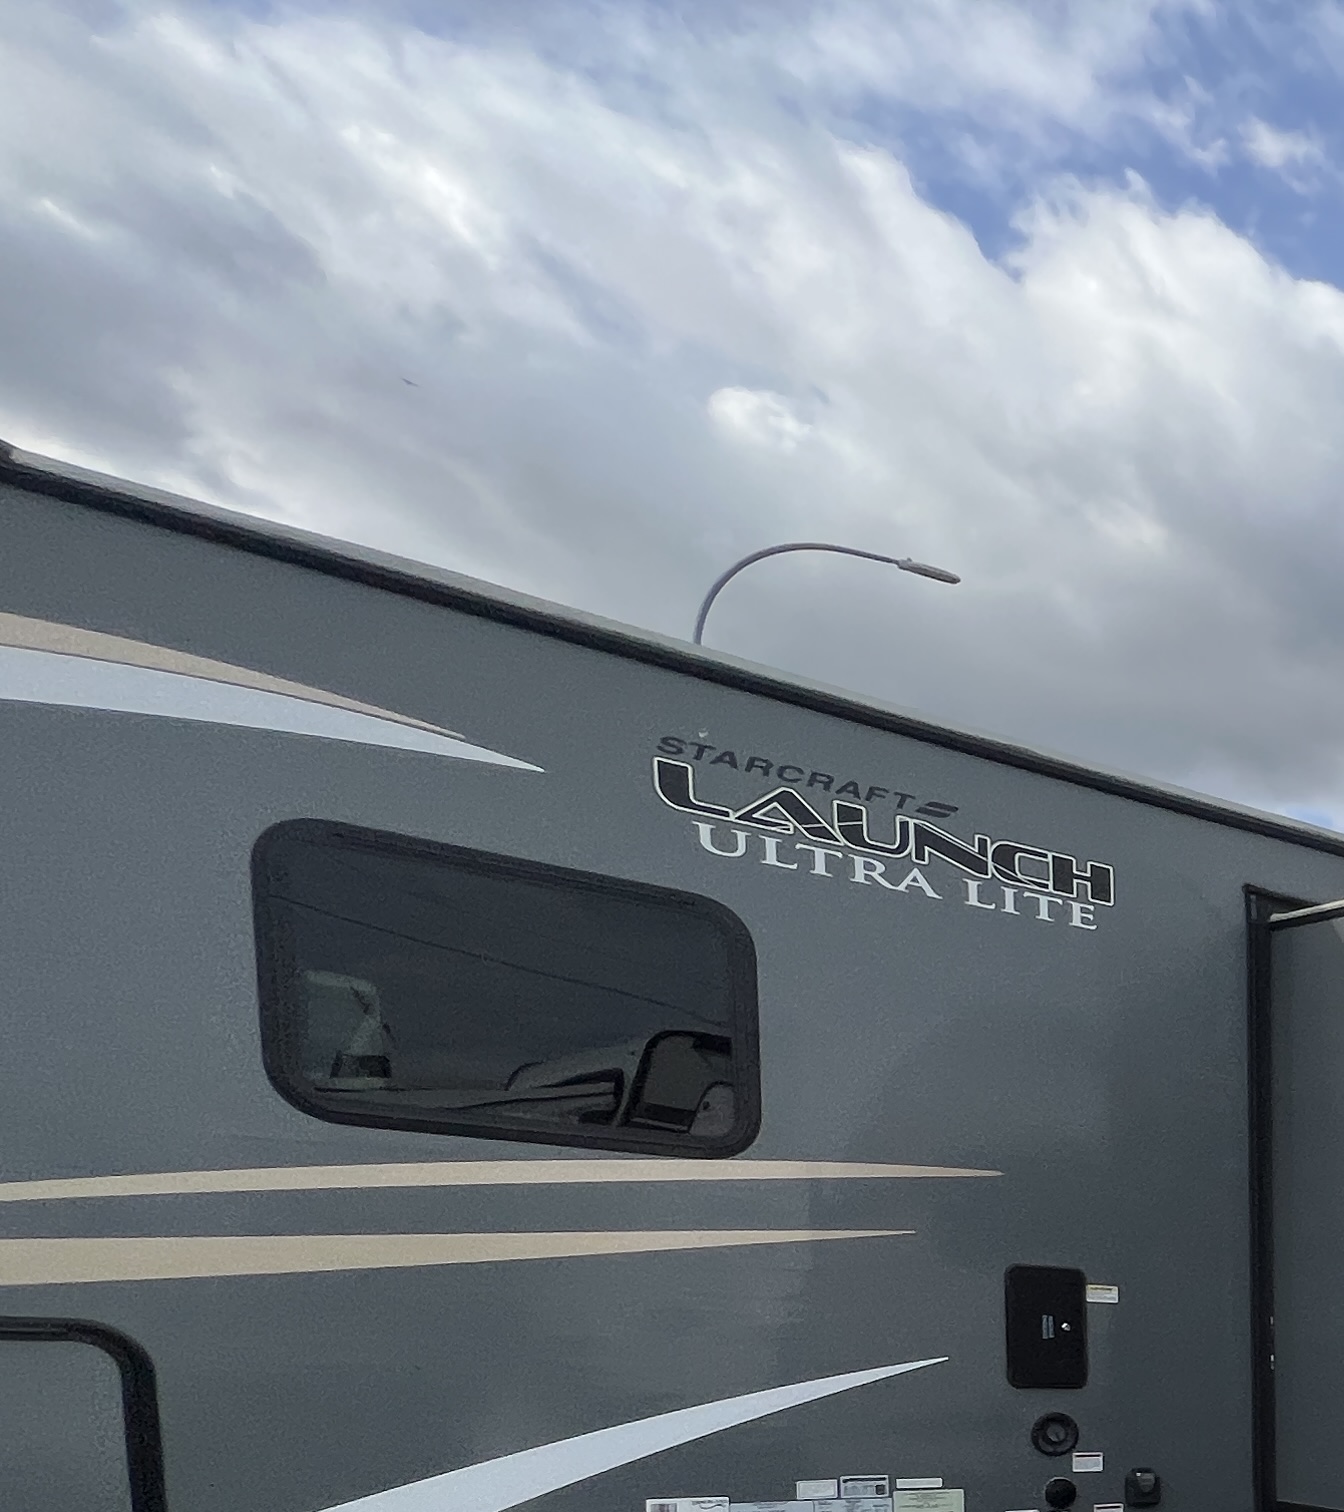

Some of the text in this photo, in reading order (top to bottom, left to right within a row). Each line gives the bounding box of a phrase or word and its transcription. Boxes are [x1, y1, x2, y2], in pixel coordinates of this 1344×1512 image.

[656, 735, 917, 803] STARCRAFT
[652, 756, 1115, 906] LAUNCH
[691, 820, 1098, 930] ULTRA LITE
